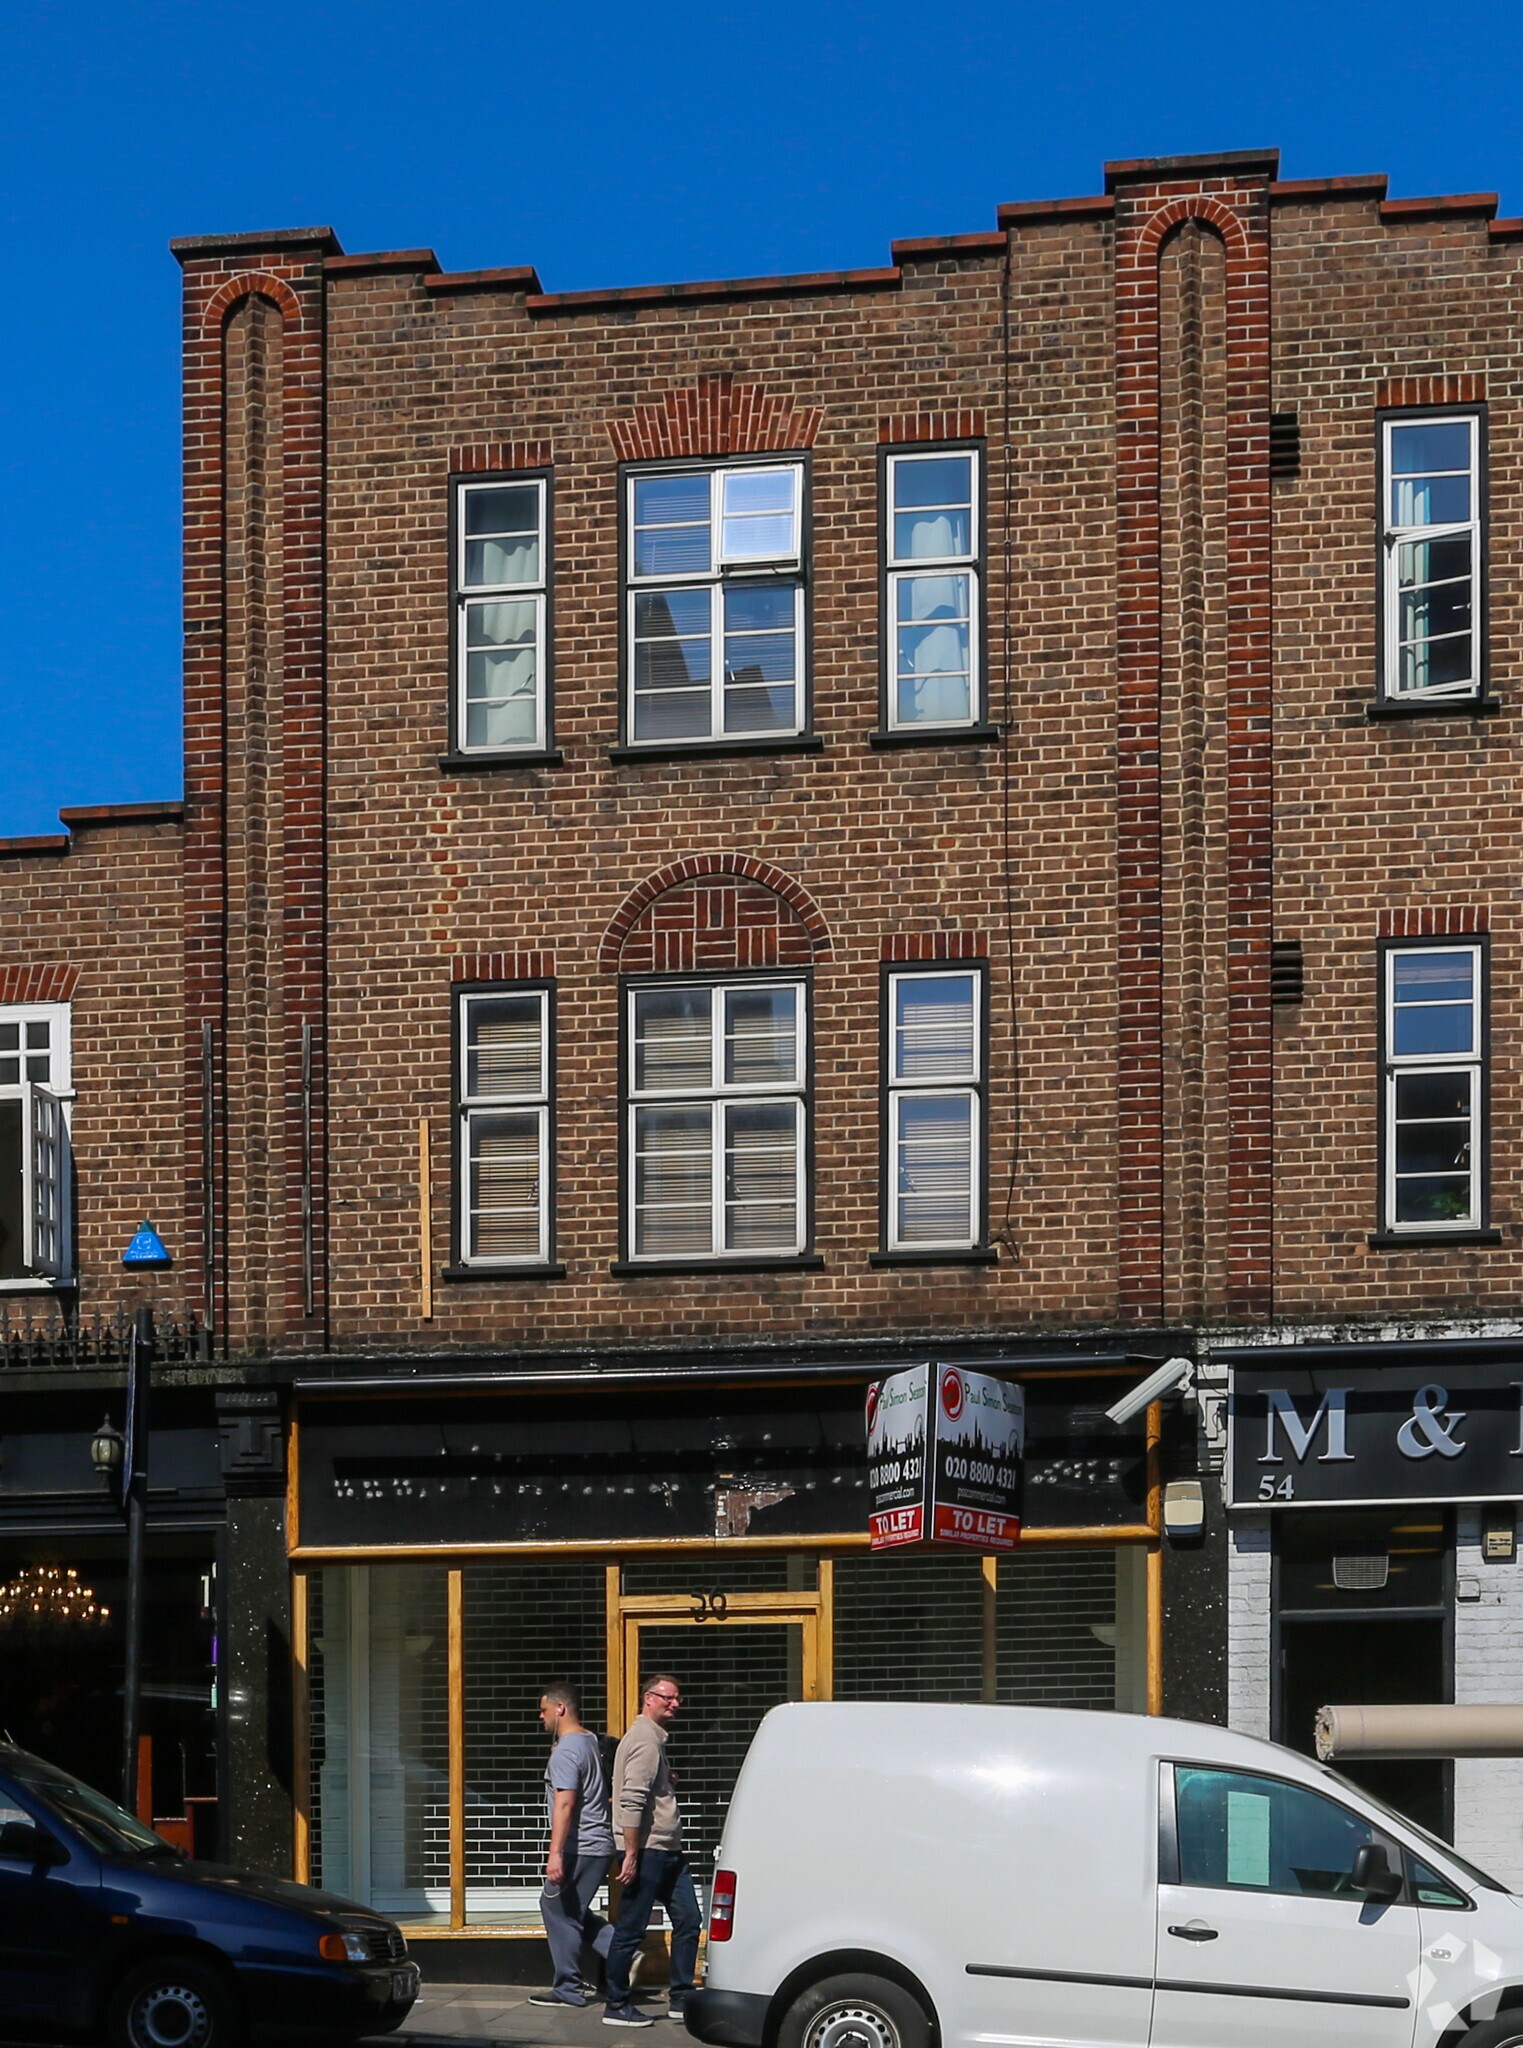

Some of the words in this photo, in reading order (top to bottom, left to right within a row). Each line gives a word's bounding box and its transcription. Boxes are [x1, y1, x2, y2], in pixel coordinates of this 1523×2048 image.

[964, 1382, 980, 1405] Paul
[982, 1386, 1001, 1410] Simon
[1257, 1387, 1355, 1461] M
[1396, 1383, 1466, 1458] &
[880, 1461, 901, 1486] 8800
[902, 1456, 922, 1481] 4321
[945, 1455, 968, 1480] 020
[969, 1460, 995, 1485] 8800
[996, 1467, 1016, 1490] 4321
[1257, 1474, 1295, 1500] 54
[875, 1515, 889, 1535] TO
[890, 1509, 916, 1532] LET
[952, 1510, 974, 1531] TO
[976, 1514, 1007, 1536] LET
